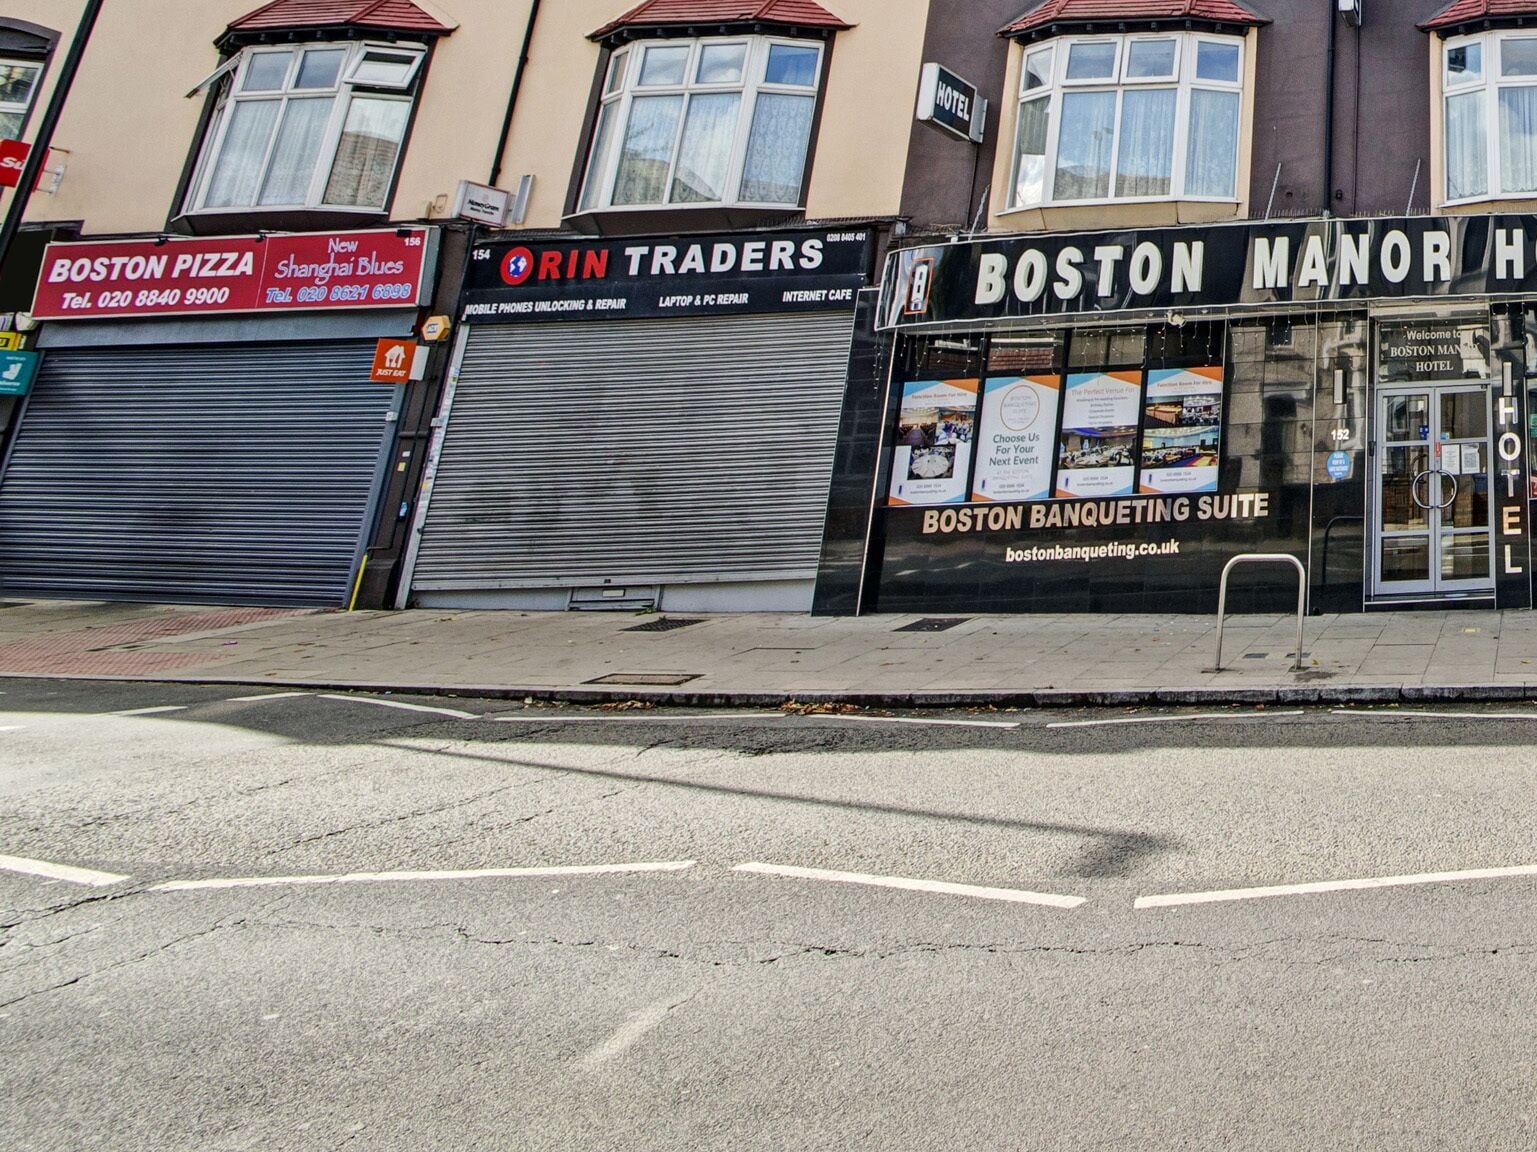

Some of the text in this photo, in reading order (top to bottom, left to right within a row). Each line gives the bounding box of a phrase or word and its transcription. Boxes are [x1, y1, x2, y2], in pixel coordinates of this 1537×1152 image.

[936, 80, 970, 122] HOTEL
[328, 237, 358, 253] New
[404, 237, 421, 246] 156
[472, 248, 491, 260] 154
[624, 238, 824, 276] TRADERS
[48, 251, 253, 283] BOSTON PIZZA
[274, 251, 403, 285] Shanghai Blues
[975, 240, 1204, 305] BOSTON
[1252, 231, 1450, 290] MANOR
[62, 286, 230, 309] Tel. 020 8840 9900
[265, 282, 412, 303] Tel. 020 8621 6898
[658, 293, 749, 307] LAPTOP & PC REPAIR
[782, 289, 852, 302] INTERNET CAFE
[465, 298, 627, 315] MOBILE PHONES UNLOCKING & REPAIR
[1406, 329, 1462, 340] Welcome to
[1390, 343, 1480, 357] BOSTON MAN
[376, 368, 406, 377] JUST EAT
[1416, 360, 1454, 372] HOTEL
[992, 432, 1040, 444] Choose Us
[1331, 429, 1350, 440] 152
[995, 444, 1035, 455] For Your
[989, 455, 1039, 466] Next Event
[1498, 397, 1523, 574] HOTEL
[922, 492, 1270, 534] BOSTON BANQUETING SUITE
[1006, 539, 1180, 563] bostonbanqueting.co.uk
